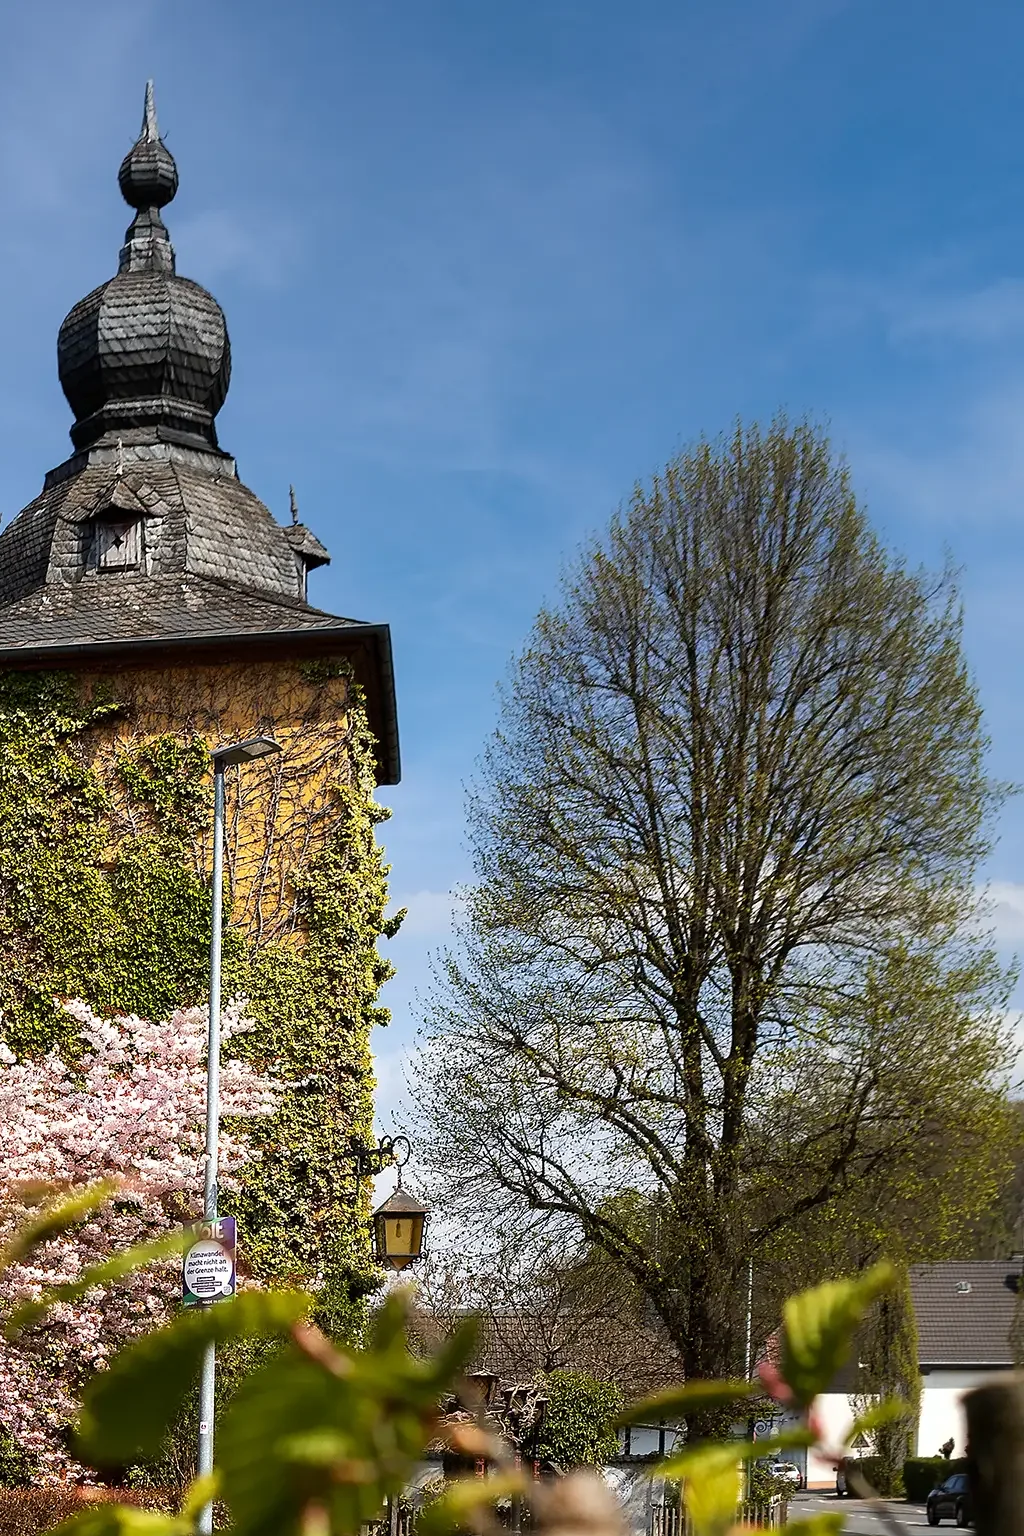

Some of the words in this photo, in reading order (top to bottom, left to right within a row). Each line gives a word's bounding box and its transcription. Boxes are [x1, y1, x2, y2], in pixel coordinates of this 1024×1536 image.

[190, 1250, 224, 1258] Klimawandel
[188, 1259, 203, 1267] macht
[214, 1265, 229, 1273] halt.
